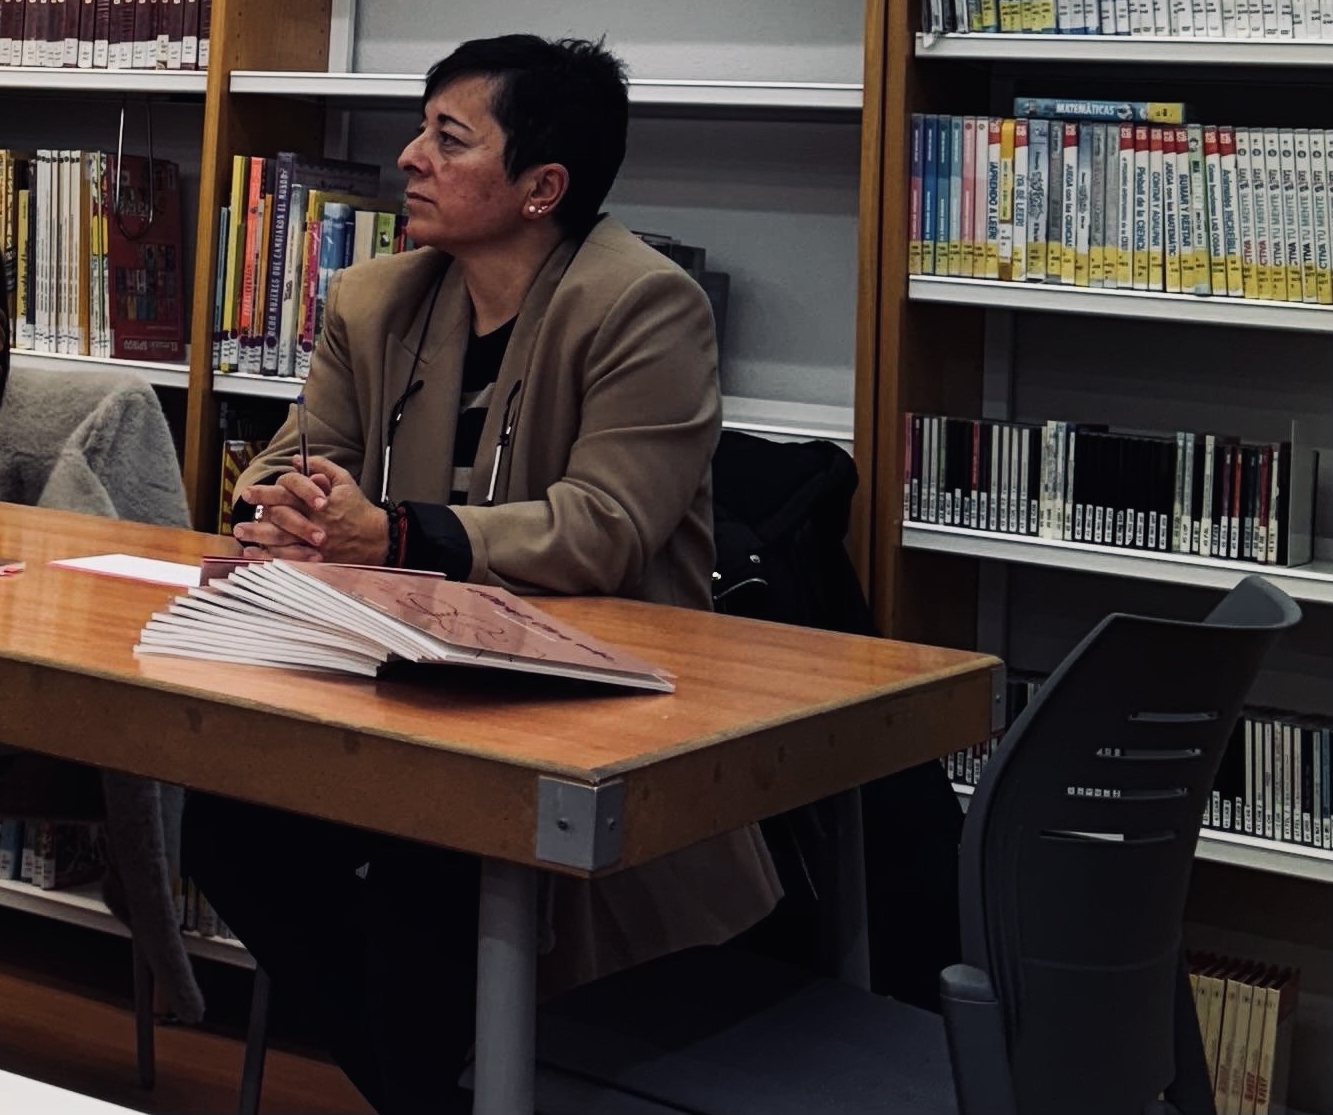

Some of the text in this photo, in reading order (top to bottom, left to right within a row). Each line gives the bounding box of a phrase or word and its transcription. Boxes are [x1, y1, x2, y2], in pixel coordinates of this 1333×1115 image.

[1056, 102, 1116, 116] MATEMÁTICAS
[1065, 164, 1074, 187] JUEGA
[1137, 166, 1145, 195] Pinball
[1165, 161, 1174, 186] JUEGA
[1015, 189, 1026, 200] SÉ
[1065, 189, 1073, 201] con
[1152, 172, 1161, 202] CONTAR
[1179, 174, 1189, 205] SUMAR
[1222, 169, 1233, 209] Animales
[277, 202, 287, 212] EL
[1137, 197, 1145, 207] de
[1241, 193, 1251, 224] MENTE
[1256, 193, 1265, 224] MENTE
[1270, 194, 1280, 225] MENTE
[1285, 194, 1295, 225] MENTE
[1300, 195, 1310, 227] MENTE
[1314, 195, 1324, 227] MENTE
[273, 214, 285, 259] CAMBIARON
[1153, 210, 1162, 247] AGRUPAR
[1181, 214, 1191, 247] RESTAR
[1210, 218, 1219, 231] LAS
[1242, 226, 1251, 238] TU
[1257, 227, 1266, 238] TU
[1272, 227, 1281, 239] TU
[1287, 228, 1296, 240] TU
[1302, 229, 1310, 241] TU
[1316, 230, 1325, 241] TU
[271, 261, 282, 276] QUE
[269, 278, 281, 313] MUJERES
